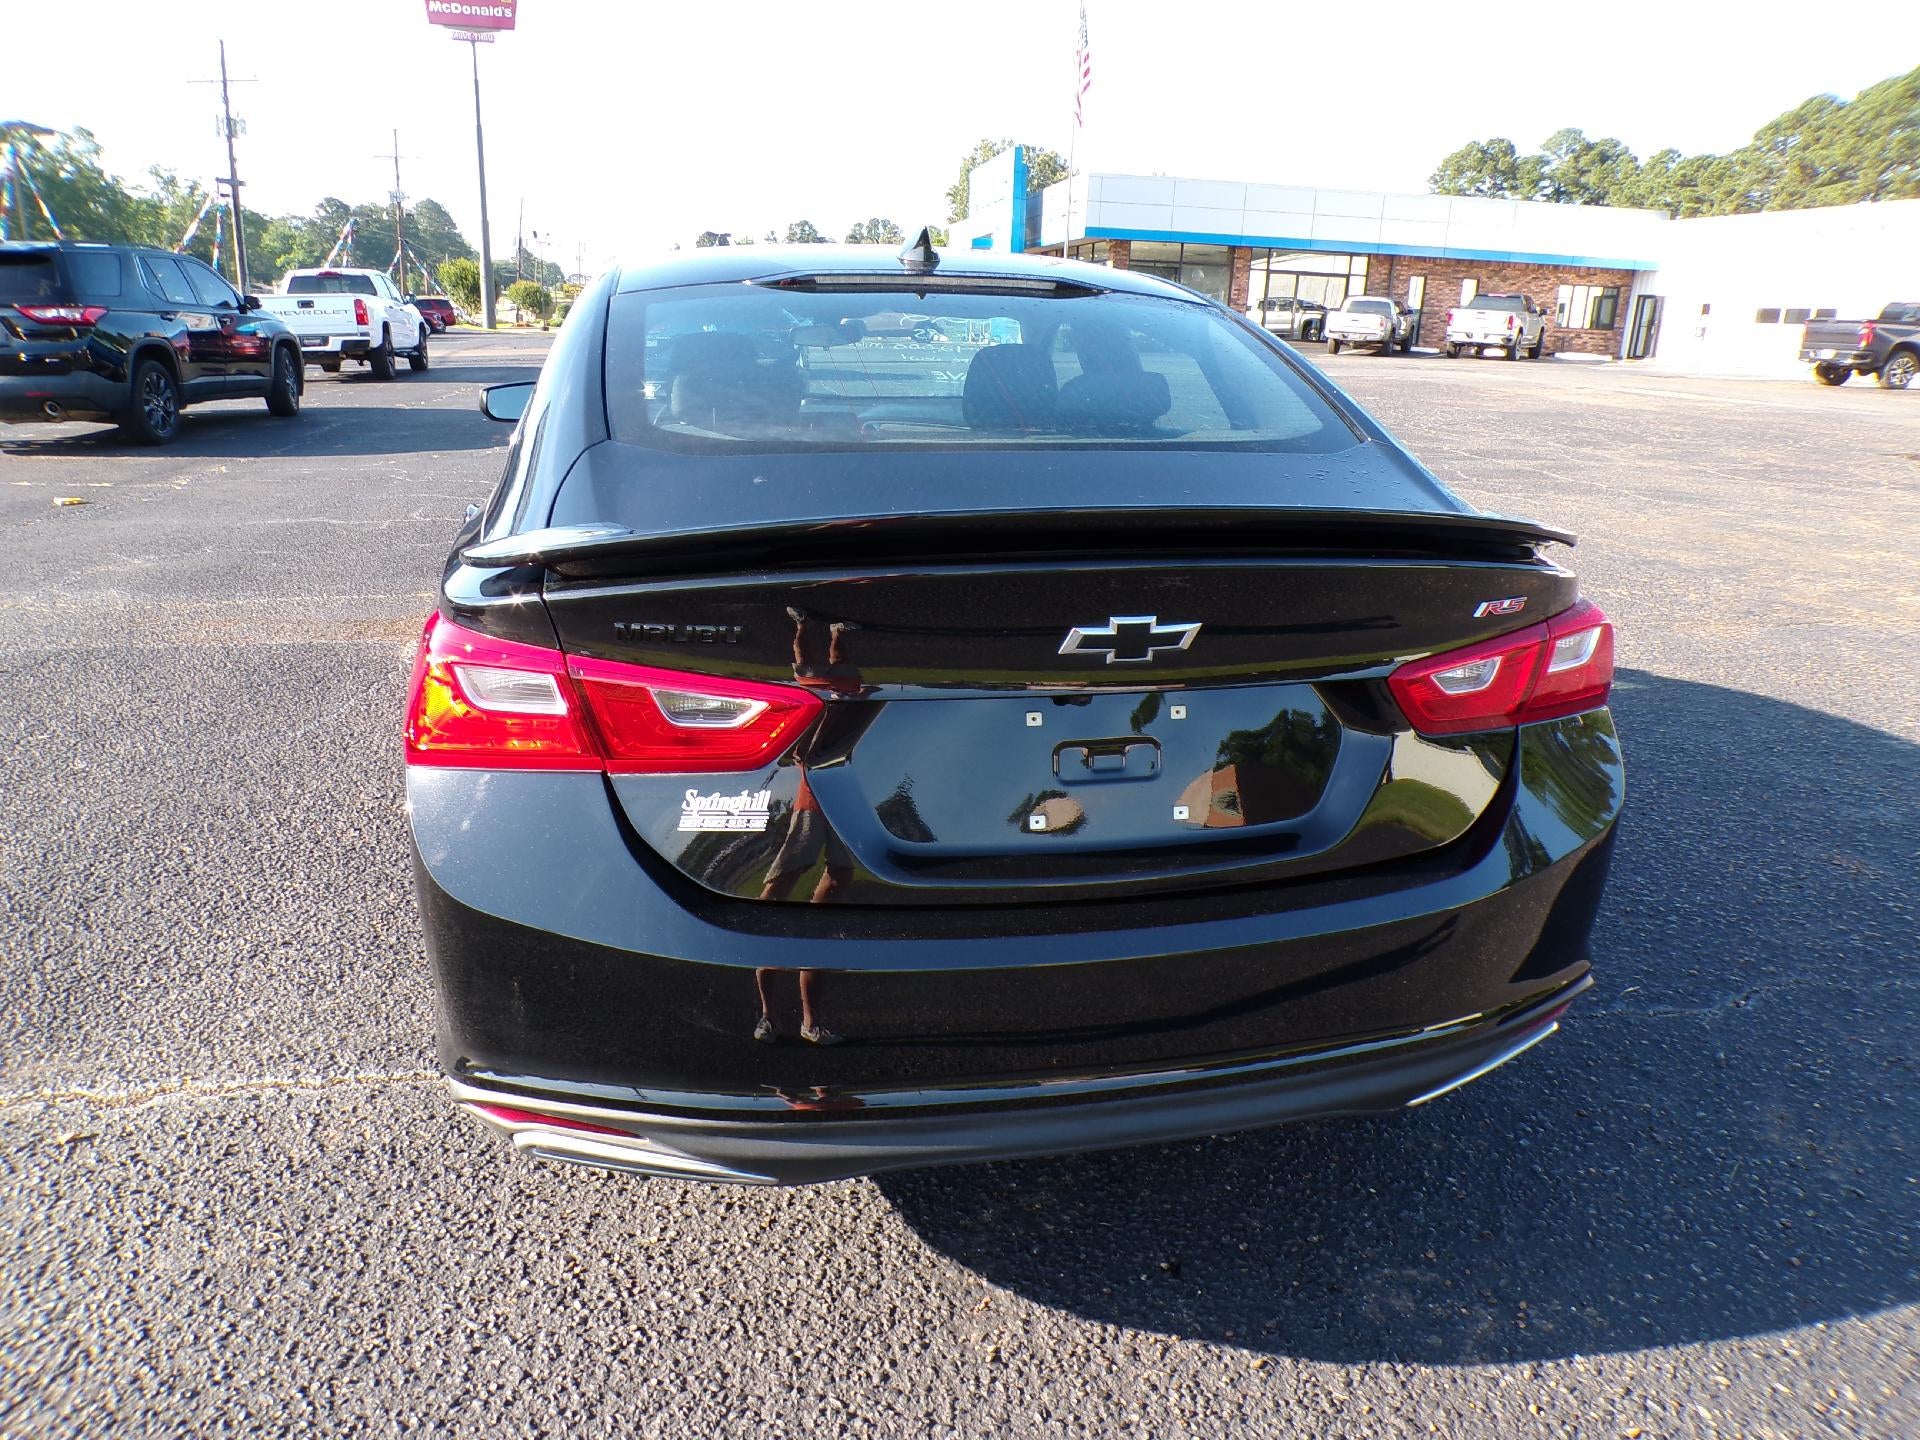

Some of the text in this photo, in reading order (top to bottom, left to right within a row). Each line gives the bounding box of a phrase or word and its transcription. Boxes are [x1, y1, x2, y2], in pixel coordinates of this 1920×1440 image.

[429, 1, 513, 18] McDonald's
[1473, 597, 1528, 618] RS
[613, 622, 744, 643] MALIBU
[681, 788, 772, 815] Springhill
